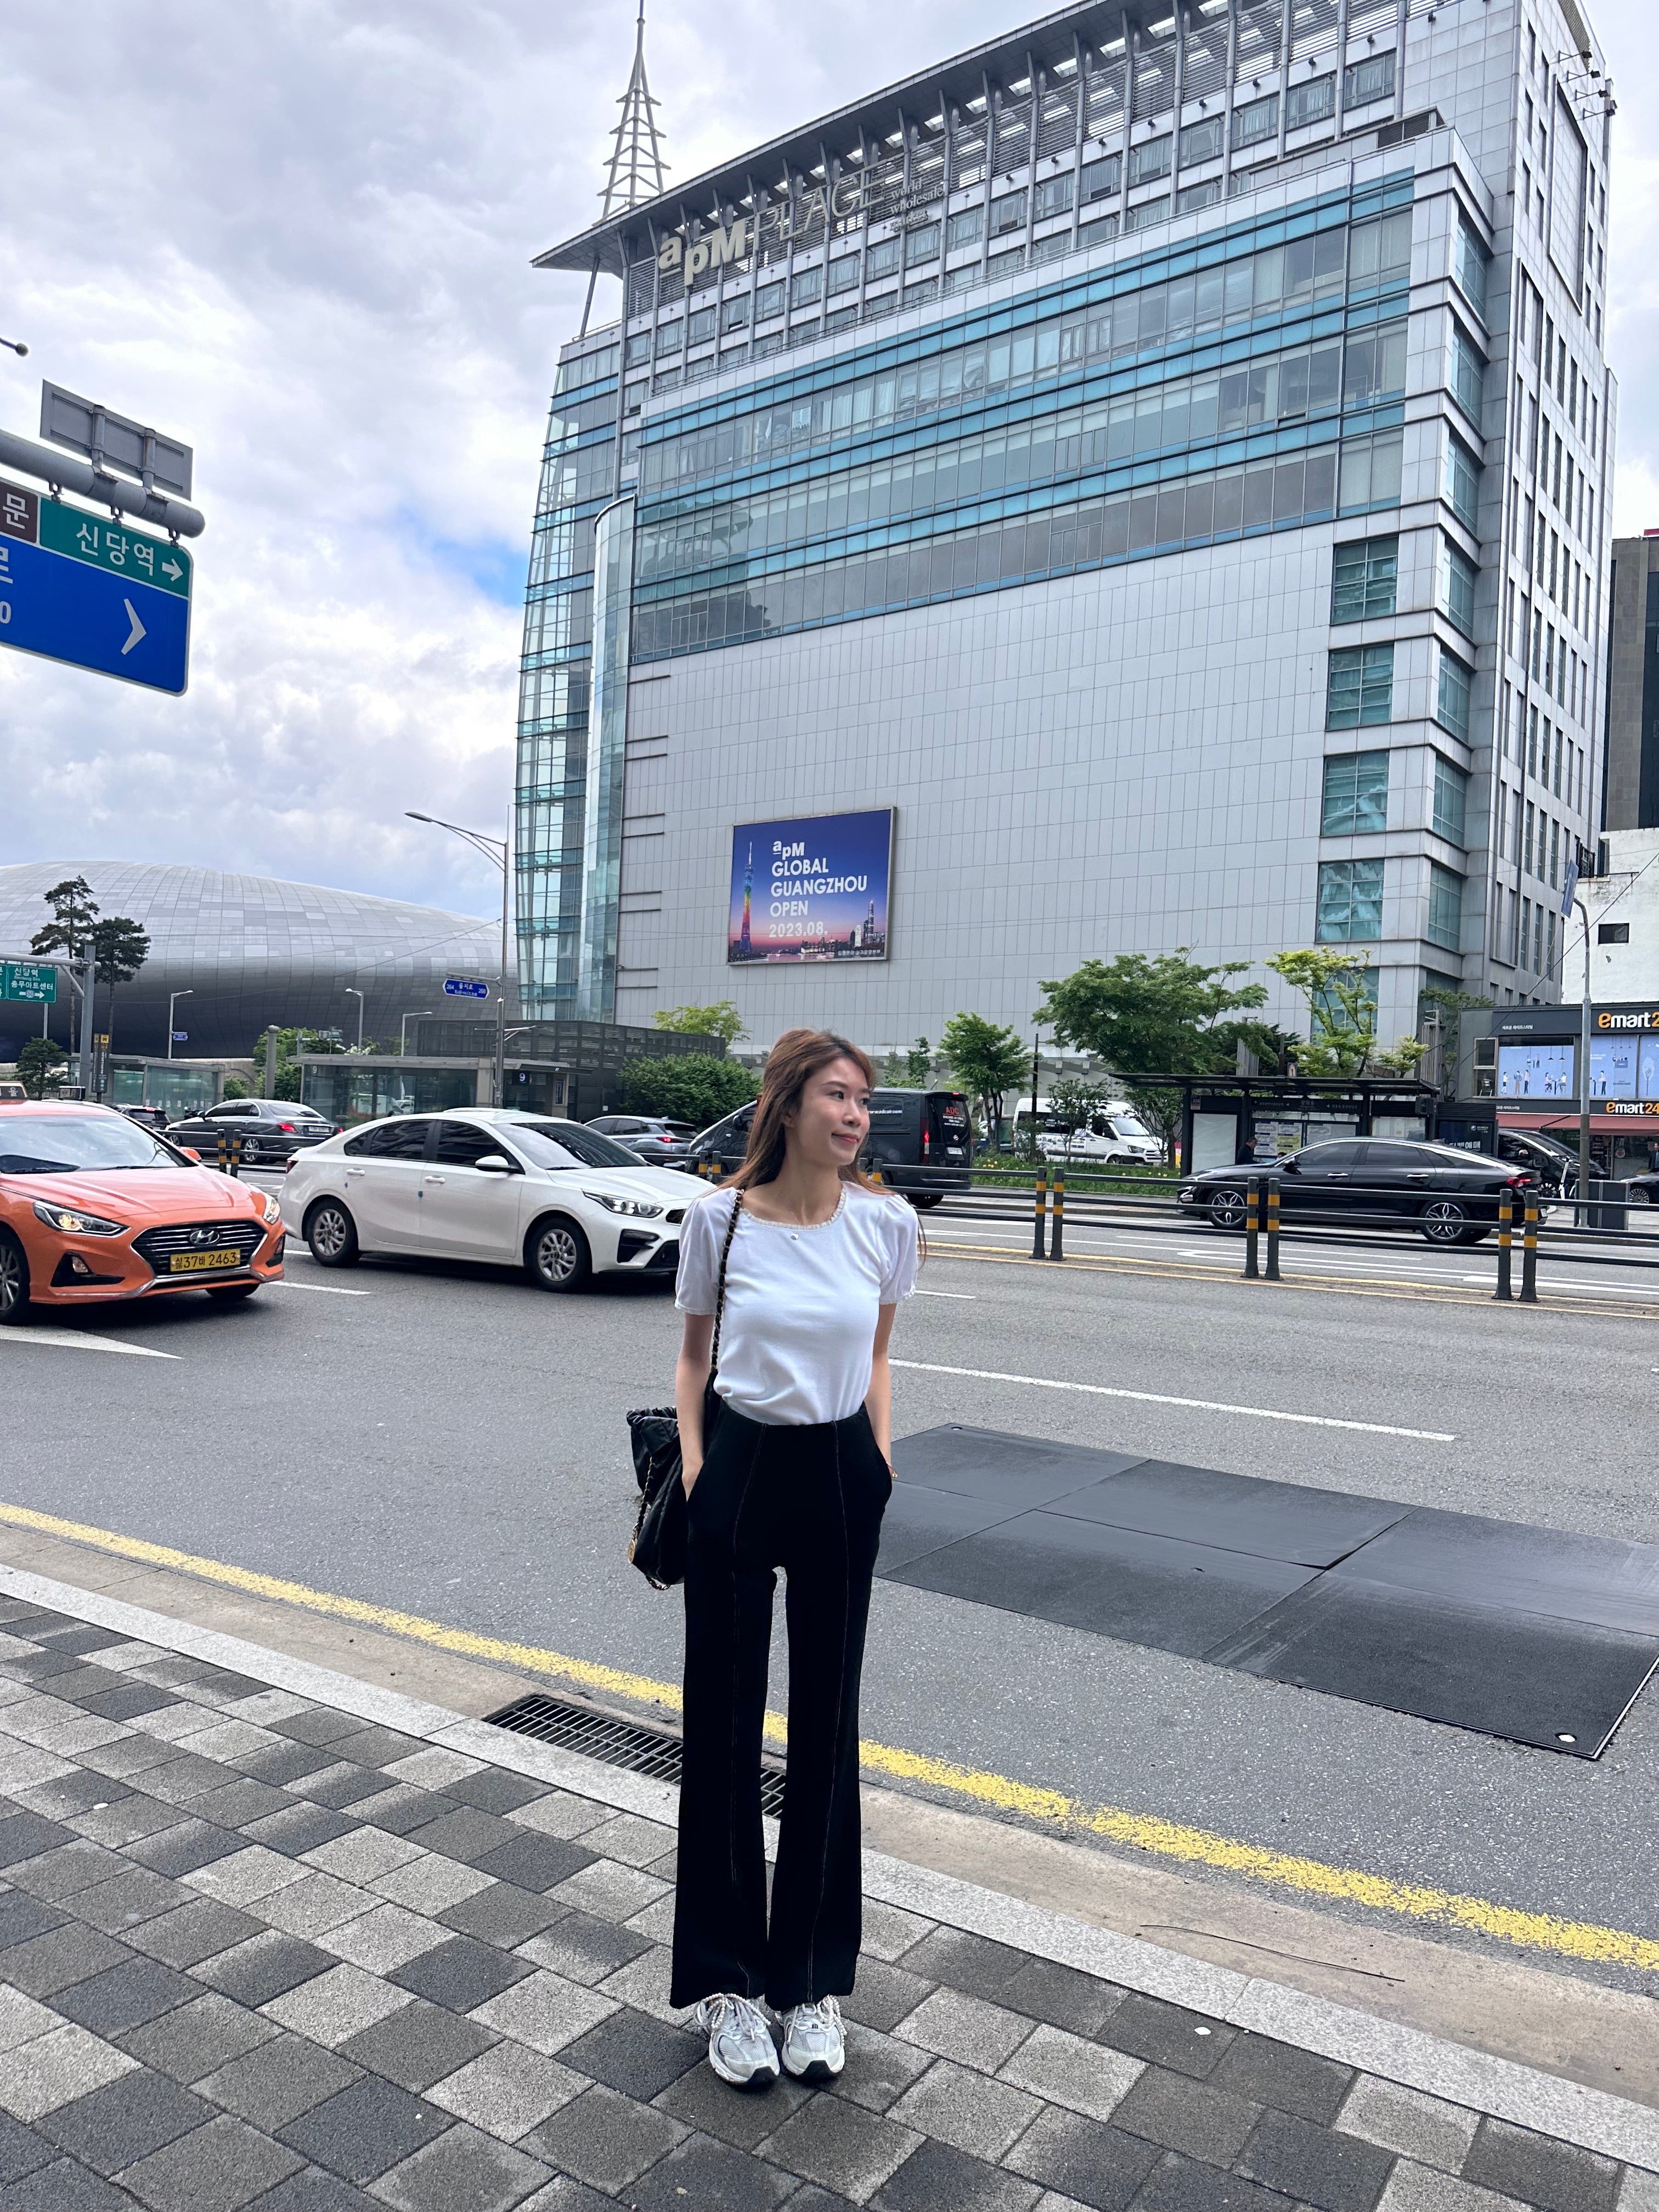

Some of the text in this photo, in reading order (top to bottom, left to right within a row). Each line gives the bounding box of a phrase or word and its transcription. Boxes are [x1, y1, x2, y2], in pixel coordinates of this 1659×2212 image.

[891, 177, 922, 200] world
[890, 185, 944, 213] wholesale
[658, 168, 885, 286] apM PLACE
[76, 522, 154, 576] 신당역
[772, 840, 805, 860] apM
[771, 857, 829, 877] GLOBAL
[770, 875, 867, 898] GUANGZHOU
[770, 900, 808, 917] OPEN
[769, 921, 828, 938] 2023.08.
[14, 967, 38, 977] 신당역
[11, 980, 53, 991] 충무아트센터
[313, 1065, 318, 1074] 9
[519, 1073, 526, 1081] 9
[946, 1106, 960, 1114] ADC
[1606, 1102, 1659, 1114] emart24
[183, 1256, 206, 1268] 37바
[208, 1252, 236, 1266] 2463
